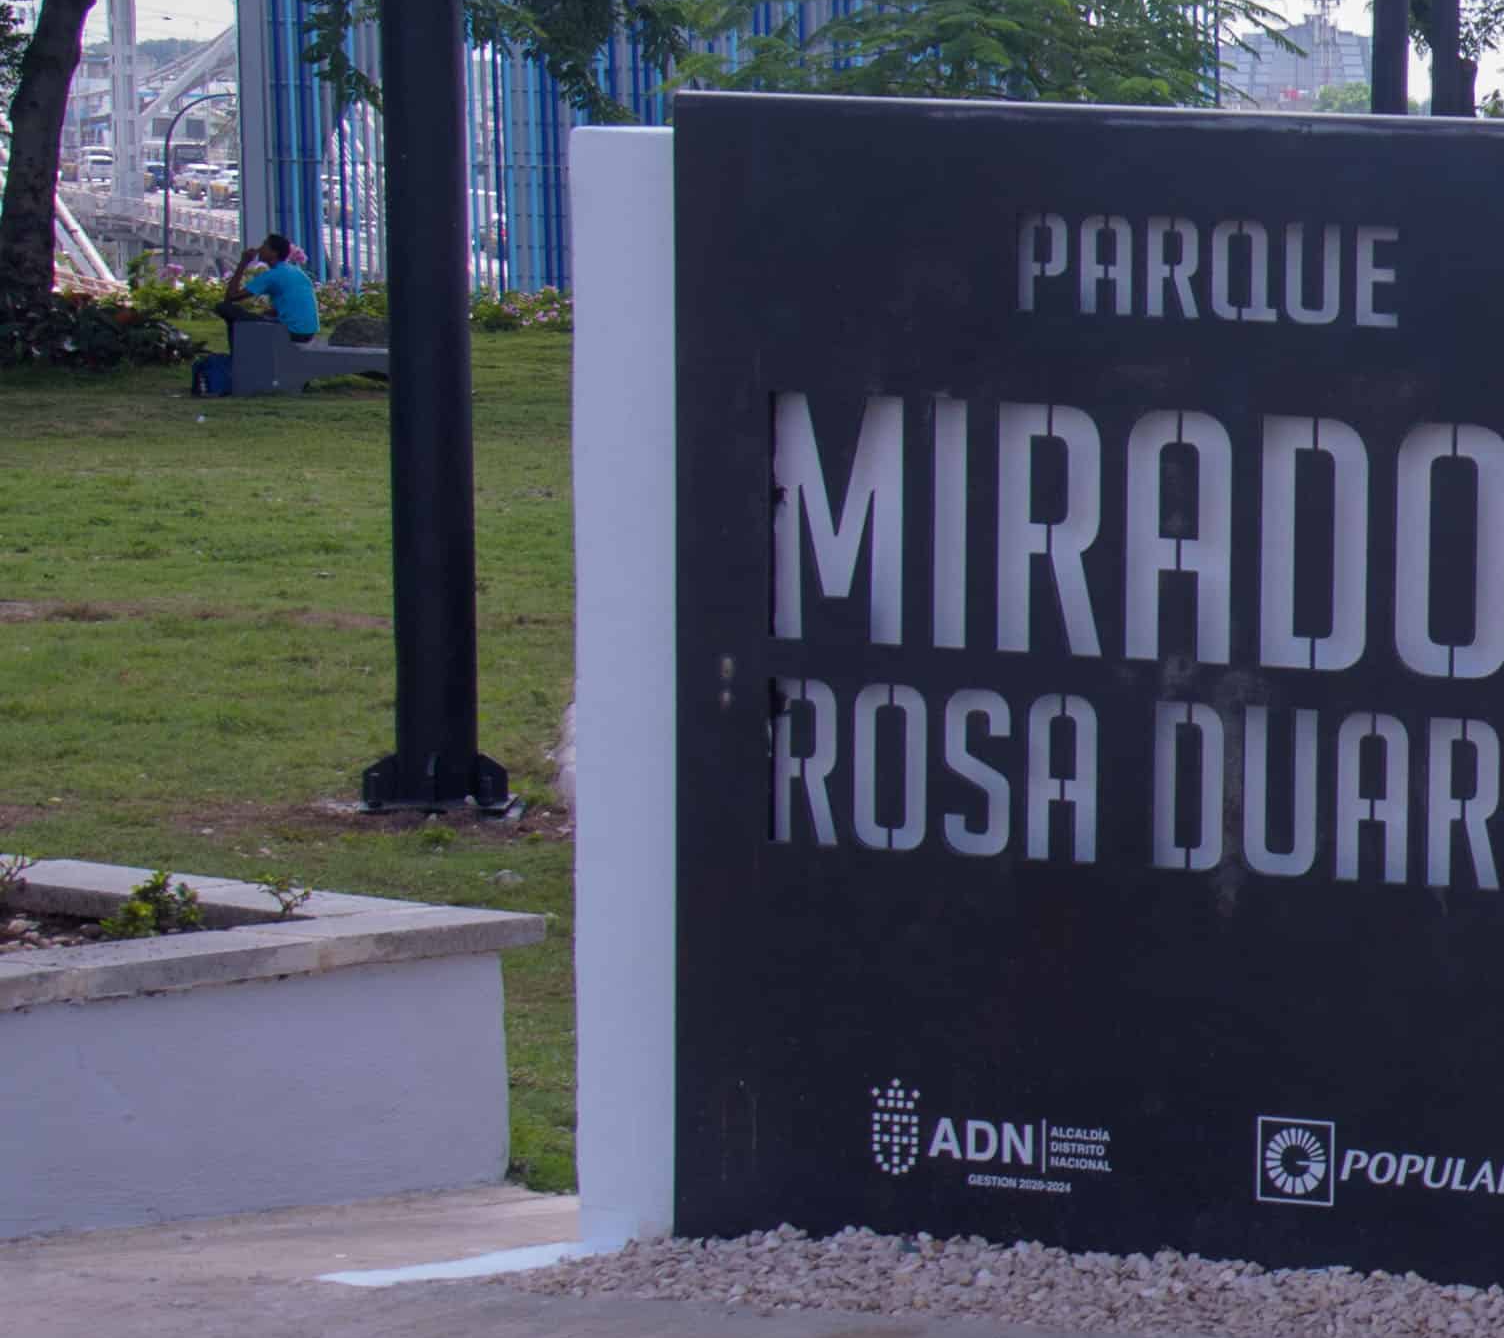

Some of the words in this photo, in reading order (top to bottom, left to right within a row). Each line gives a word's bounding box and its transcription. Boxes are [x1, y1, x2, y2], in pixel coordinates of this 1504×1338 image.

[1016, 212, 1399, 328] PARQUE
[770, 677, 1098, 864] ROSA
[928, 1117, 1034, 1166] ADN
[1050, 1141, 1105, 1157] DISTRITO
[1050, 1156, 1113, 1172] NACIONAL
